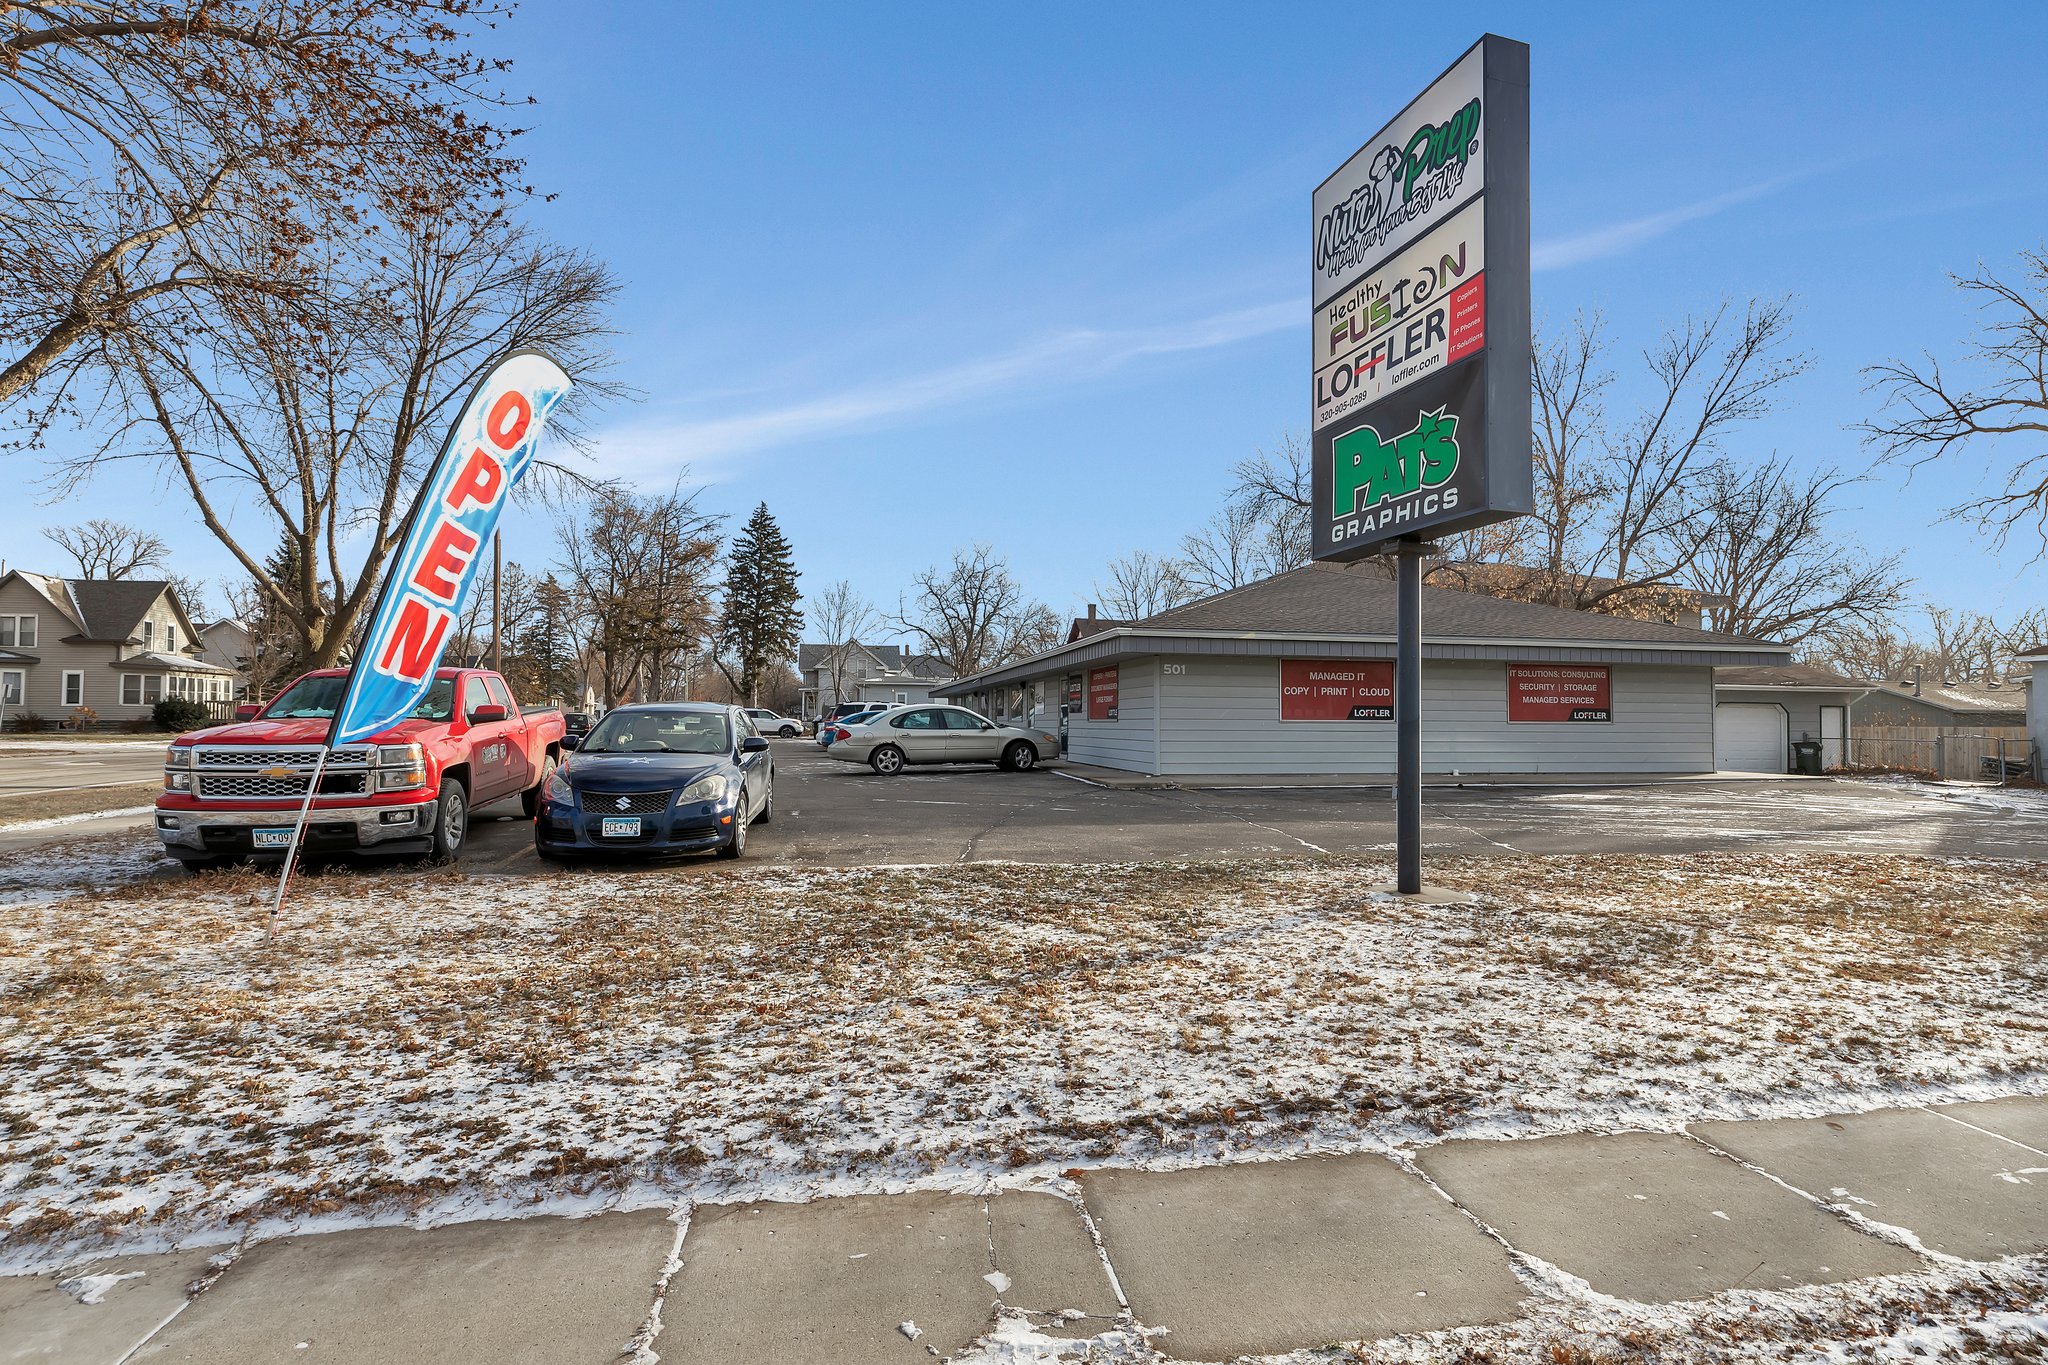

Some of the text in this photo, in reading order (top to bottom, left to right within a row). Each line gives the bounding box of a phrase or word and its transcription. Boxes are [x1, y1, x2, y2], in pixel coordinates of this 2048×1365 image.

[1394, 97, 1481, 205] Prep
[1327, 160, 1465, 278] Meals for your Best Life
[1329, 280, 1383, 325] Healthy
[1330, 241, 1466, 357] FUSION
[1456, 286, 1478, 303] Copiers
[1456, 302, 1478, 319] Printers
[1453, 317, 1481, 337] IP Phones
[1450, 331, 1483, 354] IT Solutions
[1317, 308, 1447, 408] LOFFLER
[1320, 353, 1440, 423] 320-905-0289 loffler.com
[1332, 487, 1458, 542] GRAPHICS
[381, 390, 531, 680] OPEN
[1163, 664, 1186, 675] 501
[1309, 672, 1366, 681] MANAGED IT
[1518, 670, 1560, 678] SOLUTIONS:
[1561, 671, 1607, 679] CONSULTING
[1284, 687, 1390, 697] COPY PRINT CLOUD
[1519, 683, 1597, 692] SECURITY STORAGE
[1522, 696, 1559, 704] MANAGED
[1354, 709, 1391, 717] LOFFLER
[1574, 711, 1607, 719] LOFFLER
[604, 823, 638, 832] ECE 793
[255, 833, 272, 843] NLC
